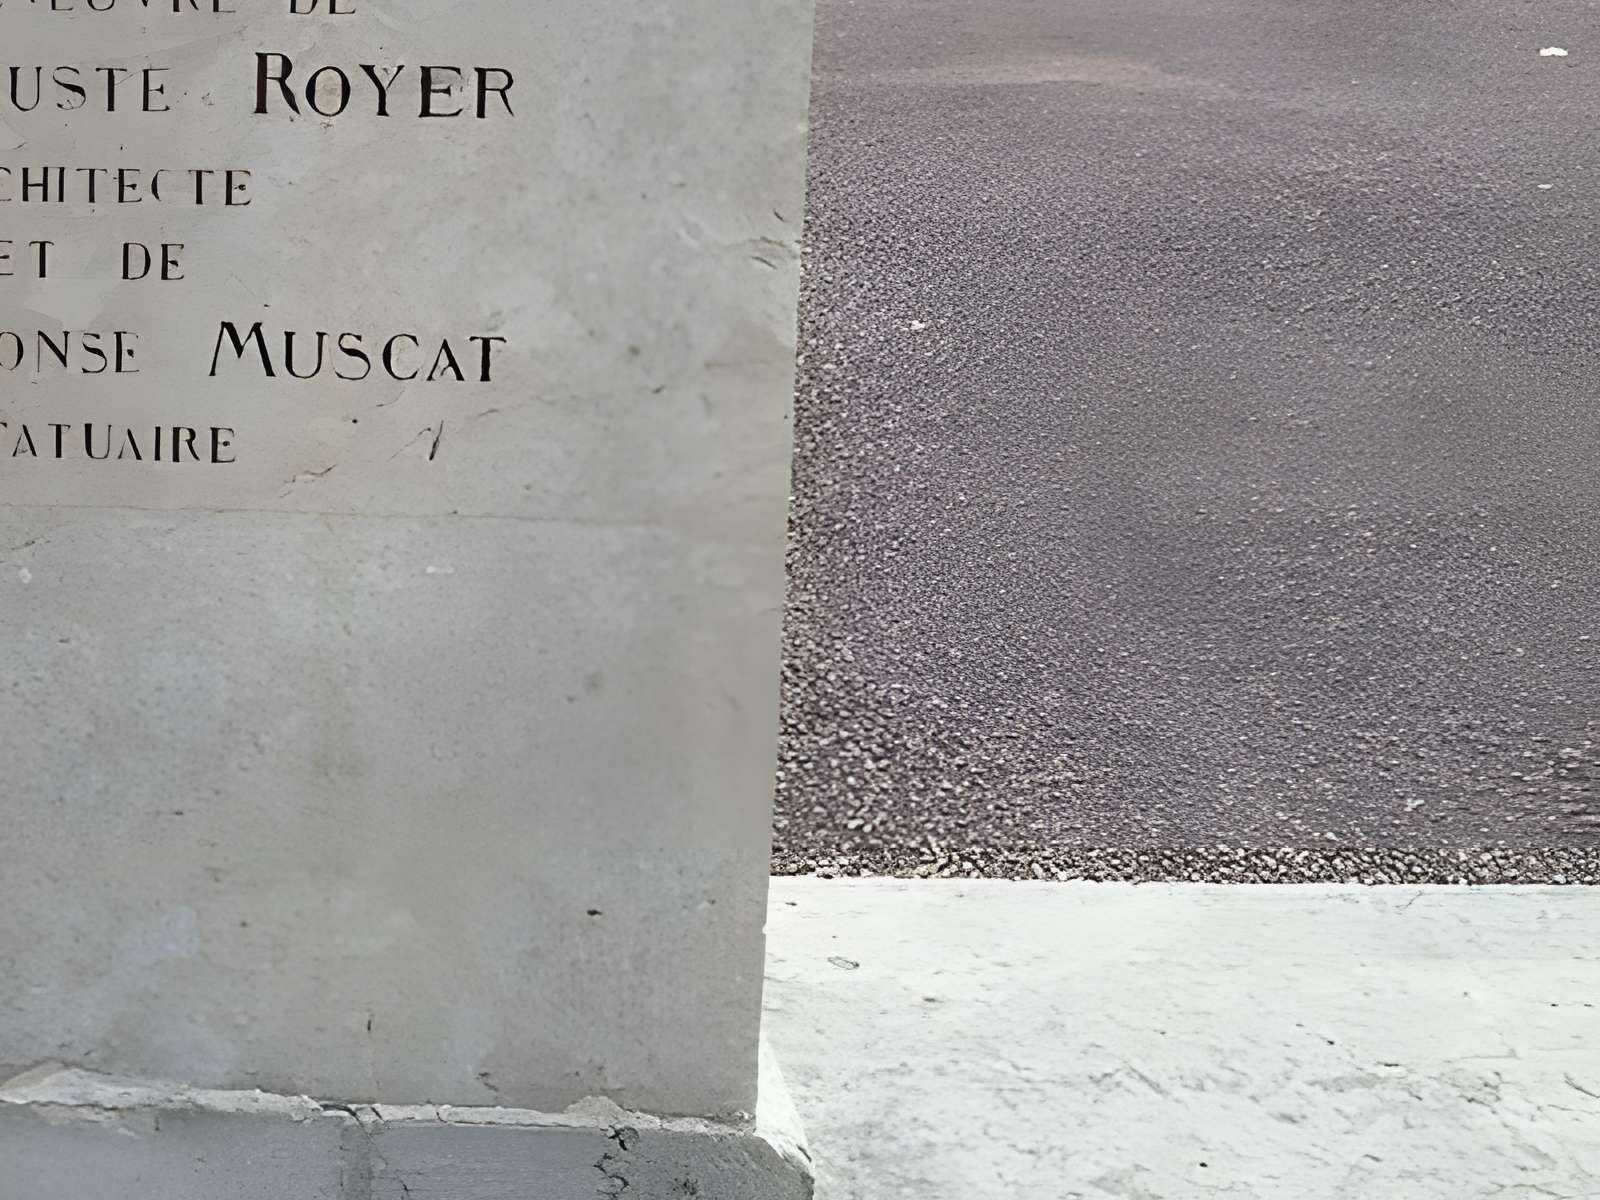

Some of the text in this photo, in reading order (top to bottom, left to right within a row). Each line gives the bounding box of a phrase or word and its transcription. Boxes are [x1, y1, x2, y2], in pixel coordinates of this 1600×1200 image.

[254, 51, 516, 119] ROYER
[122, 242, 186, 281] DE
[208, 319, 509, 382] MUSCAT
